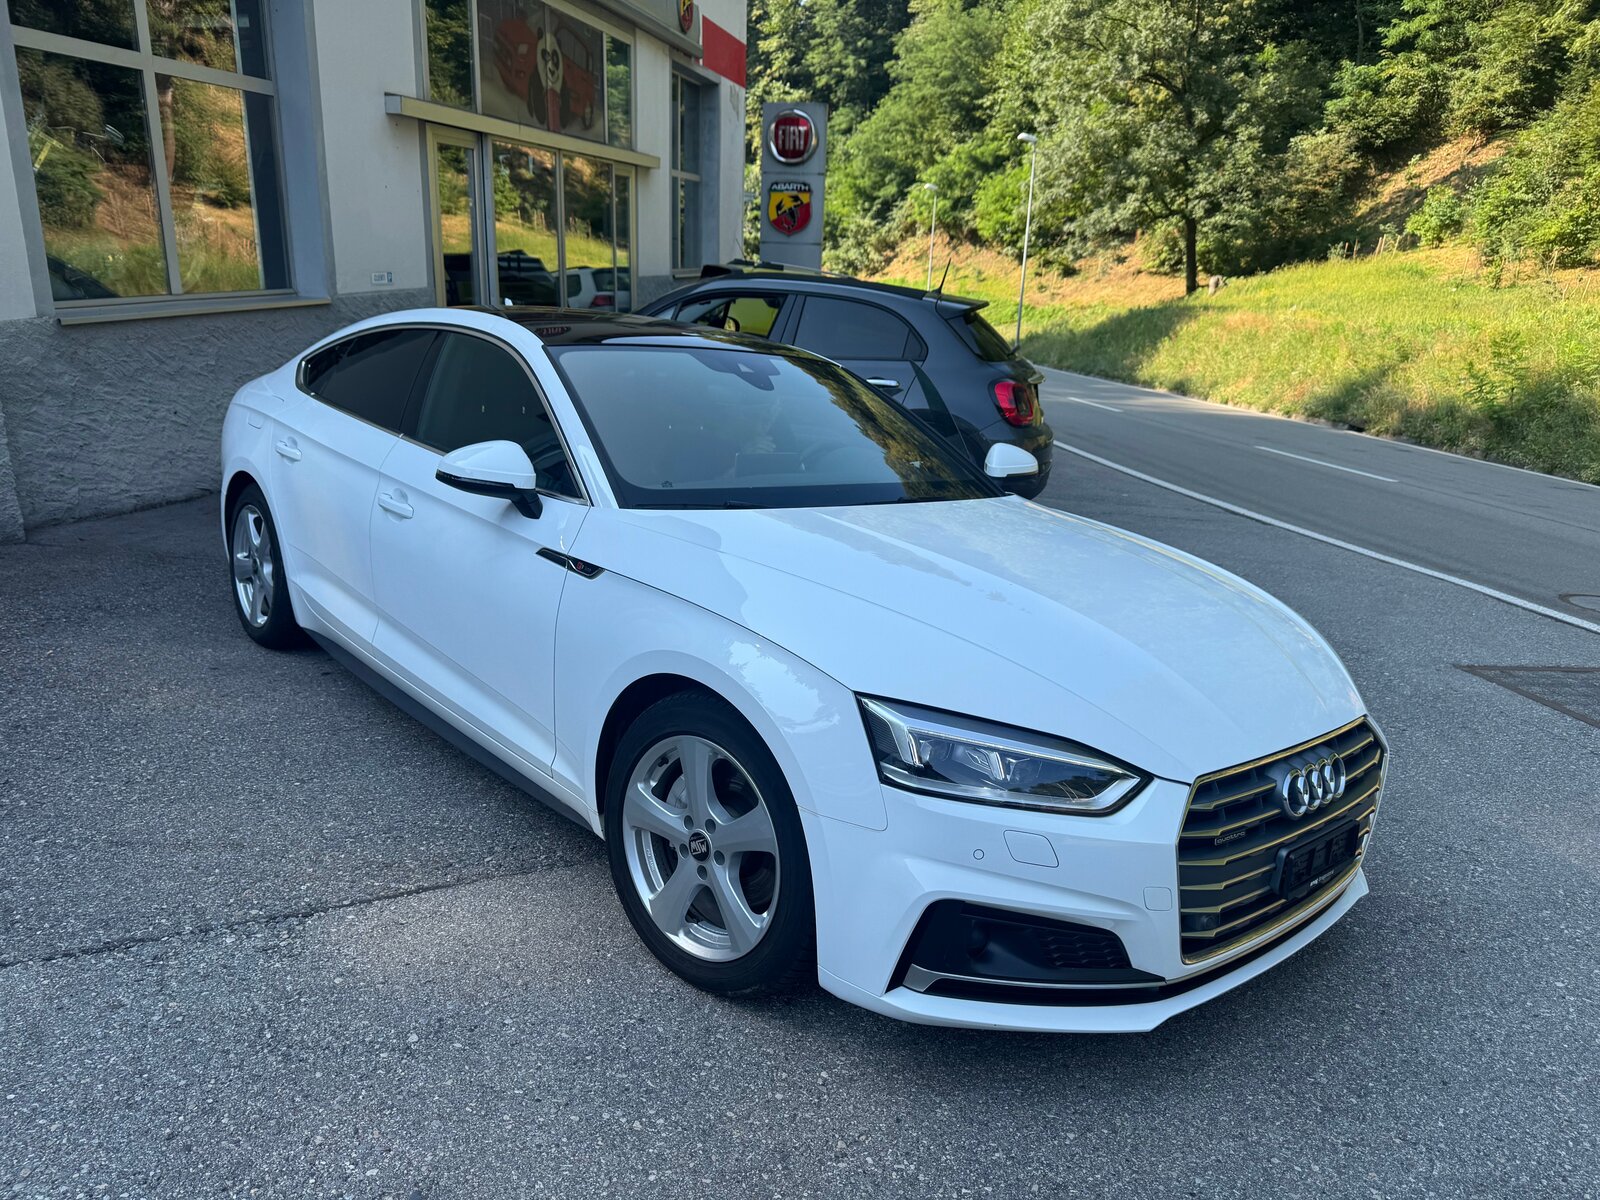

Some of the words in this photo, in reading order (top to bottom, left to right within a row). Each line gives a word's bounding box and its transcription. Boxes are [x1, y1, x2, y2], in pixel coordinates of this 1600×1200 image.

[778, 125, 808, 150] FIAT
[771, 183, 809, 191] ABARTH
[1216, 831, 1246, 845] quattro
[690, 839, 707, 855] MSW
